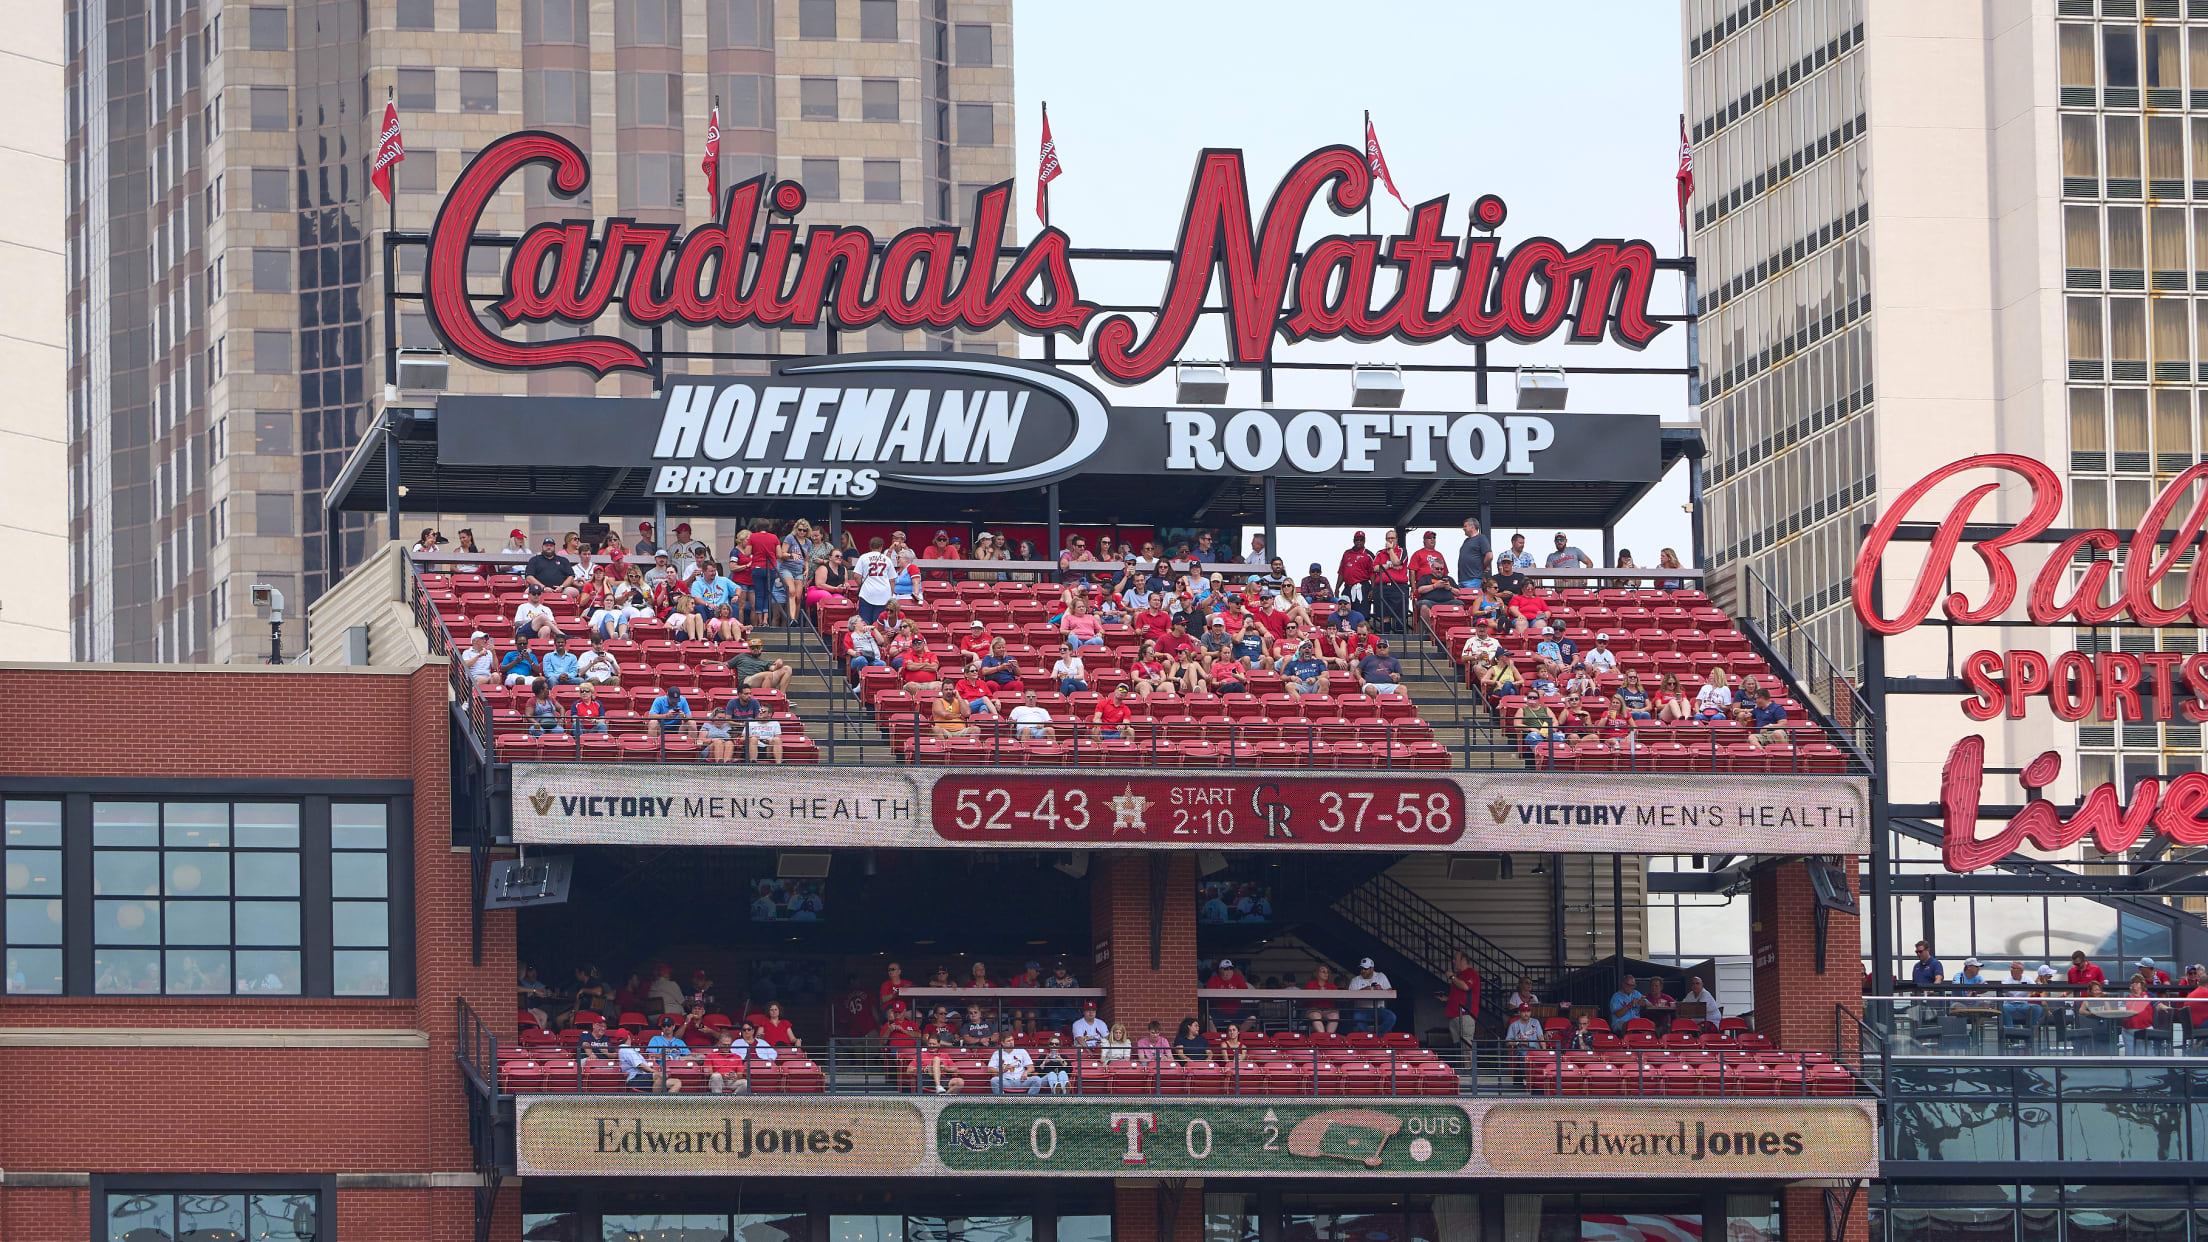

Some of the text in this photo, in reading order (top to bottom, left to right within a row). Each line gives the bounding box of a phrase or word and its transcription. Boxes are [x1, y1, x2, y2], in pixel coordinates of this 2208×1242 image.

[425, 130, 1673, 385] Cardinals Nation
[651, 383, 1031, 464] HOFFMANN
[1164, 409, 1556, 475] ROOFTOP
[652, 465, 881, 497] BROTHERS
[868, 562, 887, 577] 27
[560, 795, 910, 820] VICTORY MEN'S HEALTH
[954, 788, 1091, 830] 52-43
[1169, 787, 1236, 806] START
[1318, 791, 1453, 834] 37-58
[1517, 804, 1855, 828] VICTORY MEN'S HEALTH
[1172, 808, 1235, 836] 2:10
[593, 1116, 855, 1159] Edward Jones
[1030, 1118, 1057, 1159] 0
[1110, 1112, 1157, 1164] T
[1185, 1119, 1212, 1159] 0
[1263, 1126, 1279, 1150] 2
[1407, 1116, 1461, 1135] OUTS
[1553, 1119, 1804, 1160] Edward Jones
